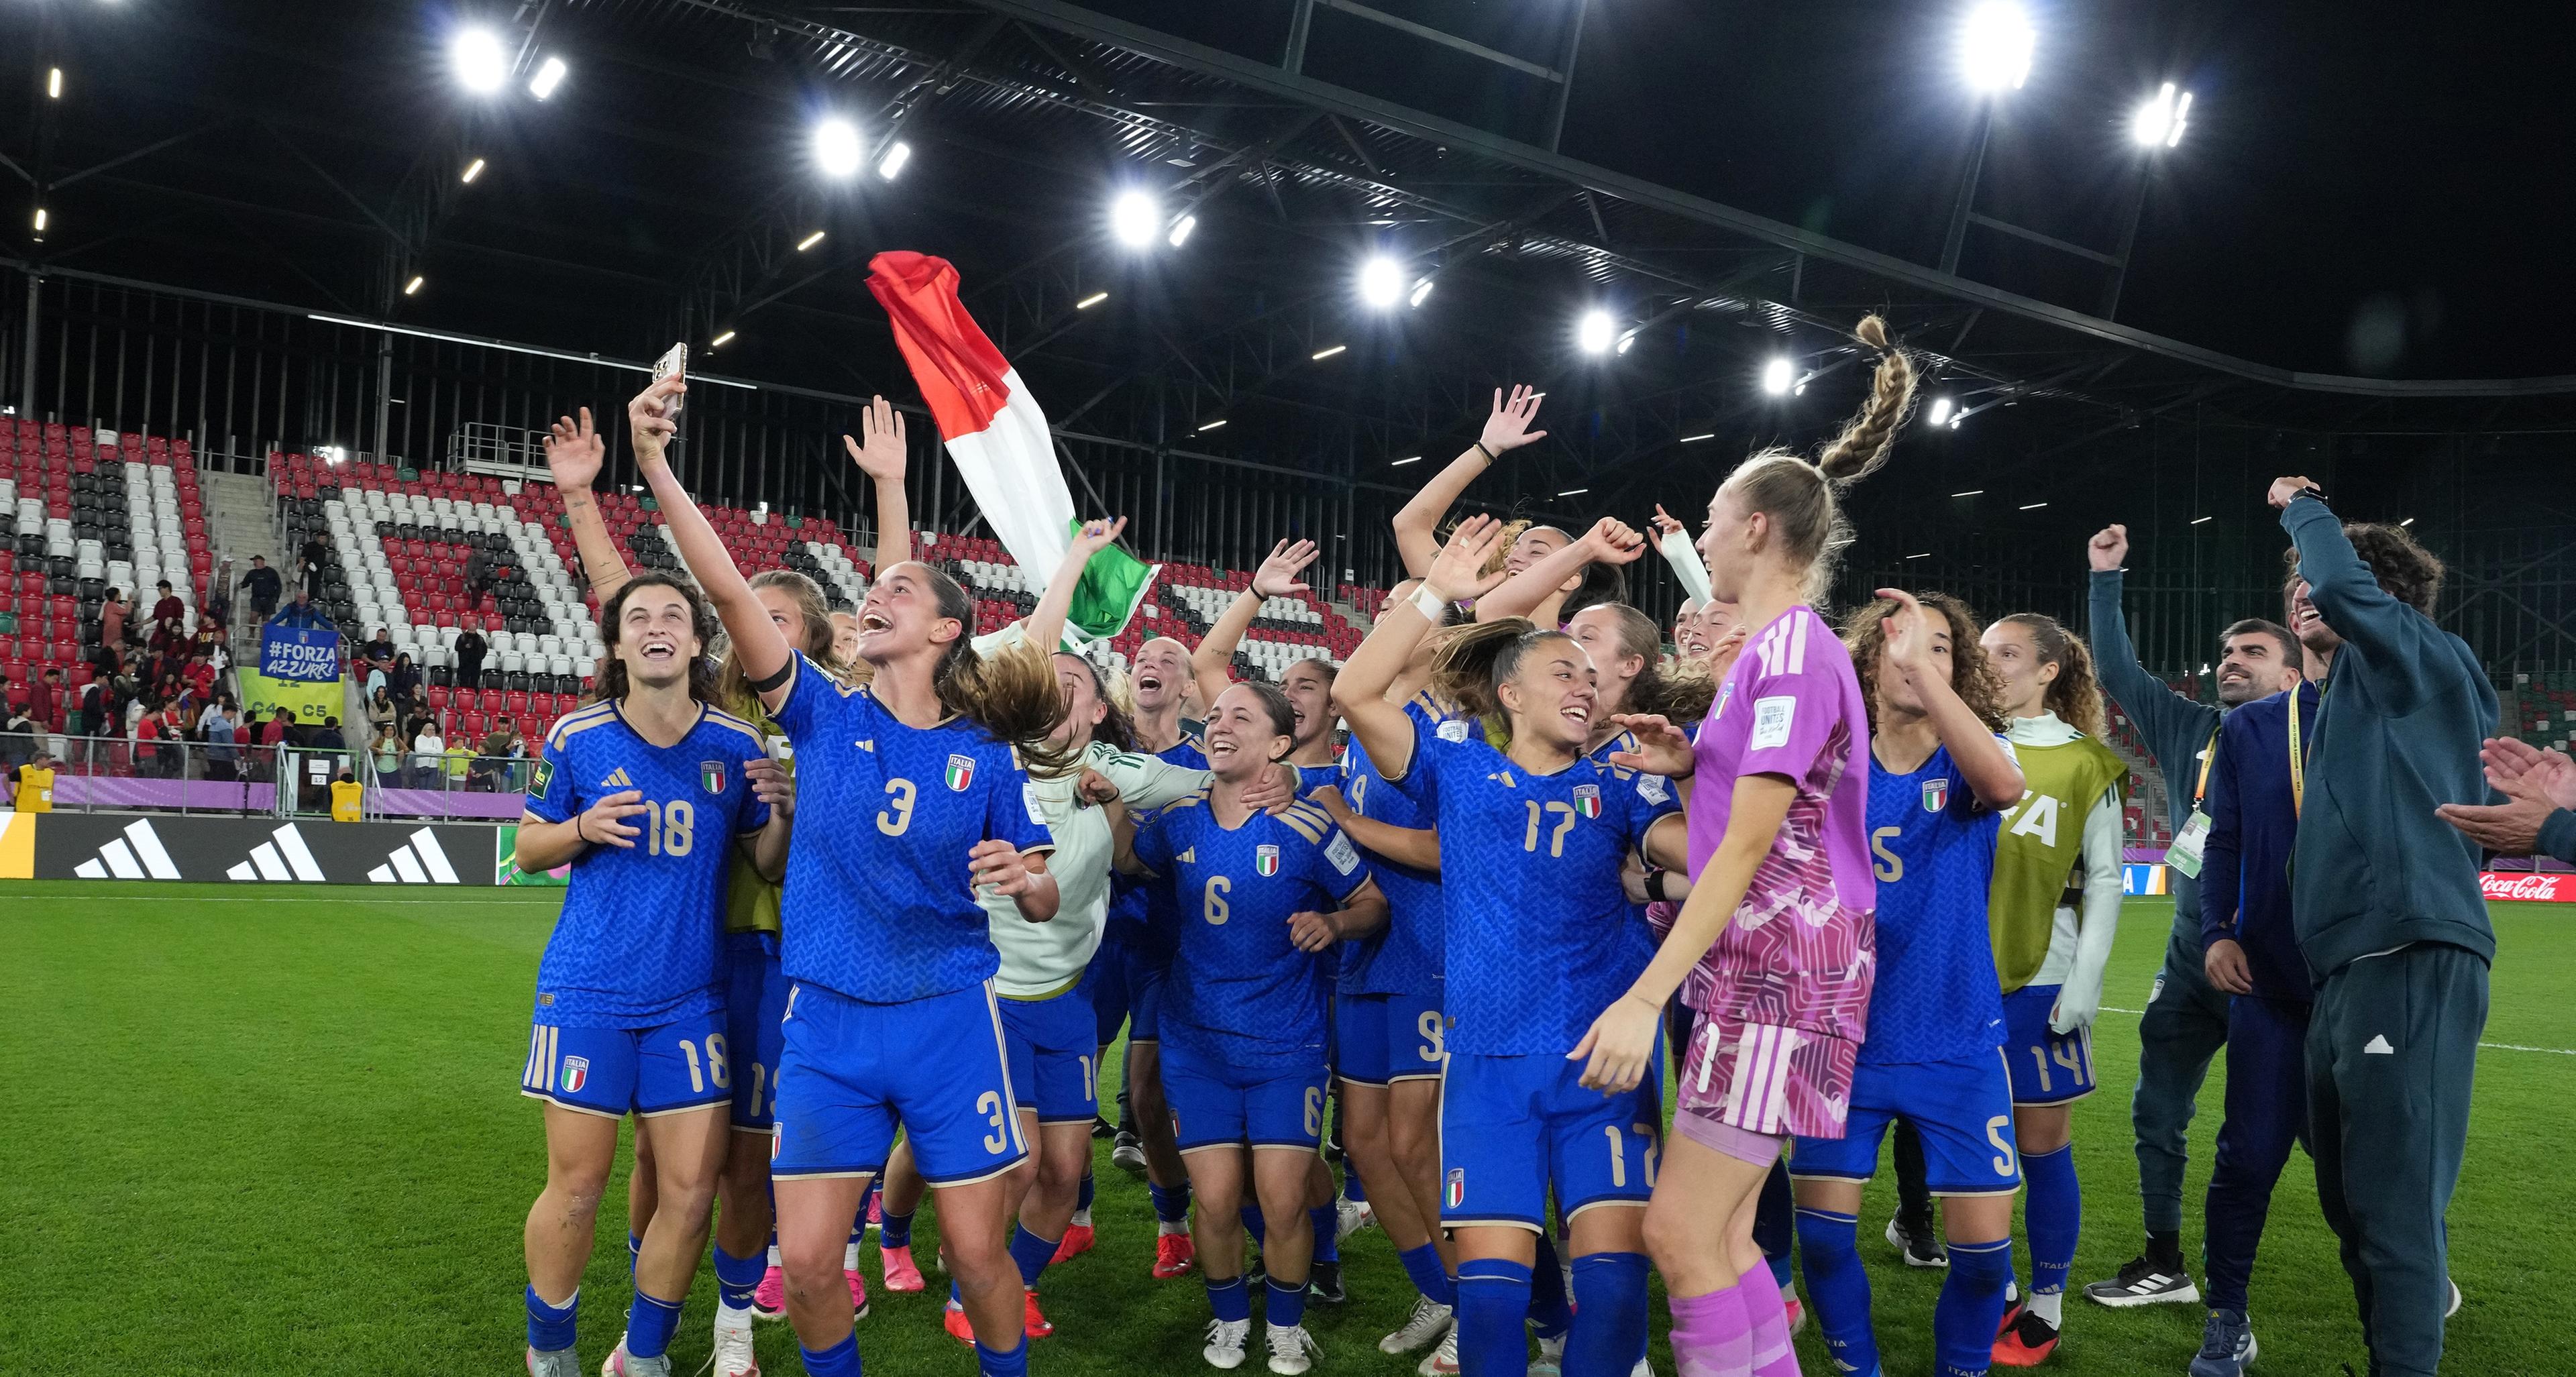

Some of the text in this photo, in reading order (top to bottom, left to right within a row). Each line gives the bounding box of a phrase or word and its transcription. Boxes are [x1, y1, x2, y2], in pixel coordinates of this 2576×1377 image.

[267, 660, 335, 680] AZZURRI
[269, 641, 335, 662] #FORZA
[252, 701, 326, 717] C4 C5
[1761, 712, 1784, 725] UNITES
[951, 756, 973, 769] ITALIA
[876, 777, 917, 836] 3
[1576, 787, 1598, 797] ITALIA
[645, 800, 694, 857] 18
[1524, 800, 1575, 858] 17
[1872, 826, 1903, 883] 5
[1204, 876, 1231, 926] 6
[566, 1058, 586, 1068] ITALIA
[680, 1032, 729, 1093] 18
[1418, 1011, 1444, 1062] 9
[1697, 1022, 1721, 1093] 1
[750, 1062, 781, 1117] 1
[2031, 1038, 2083, 1093] 14
[976, 1090, 1008, 1155] 3
[1303, 1087, 1322, 1136] 6
[1605, 1122, 1658, 1187] 17
[1986, 1115, 2014, 1176] 5
[2039, 1260, 2071, 1270] ITALIA
